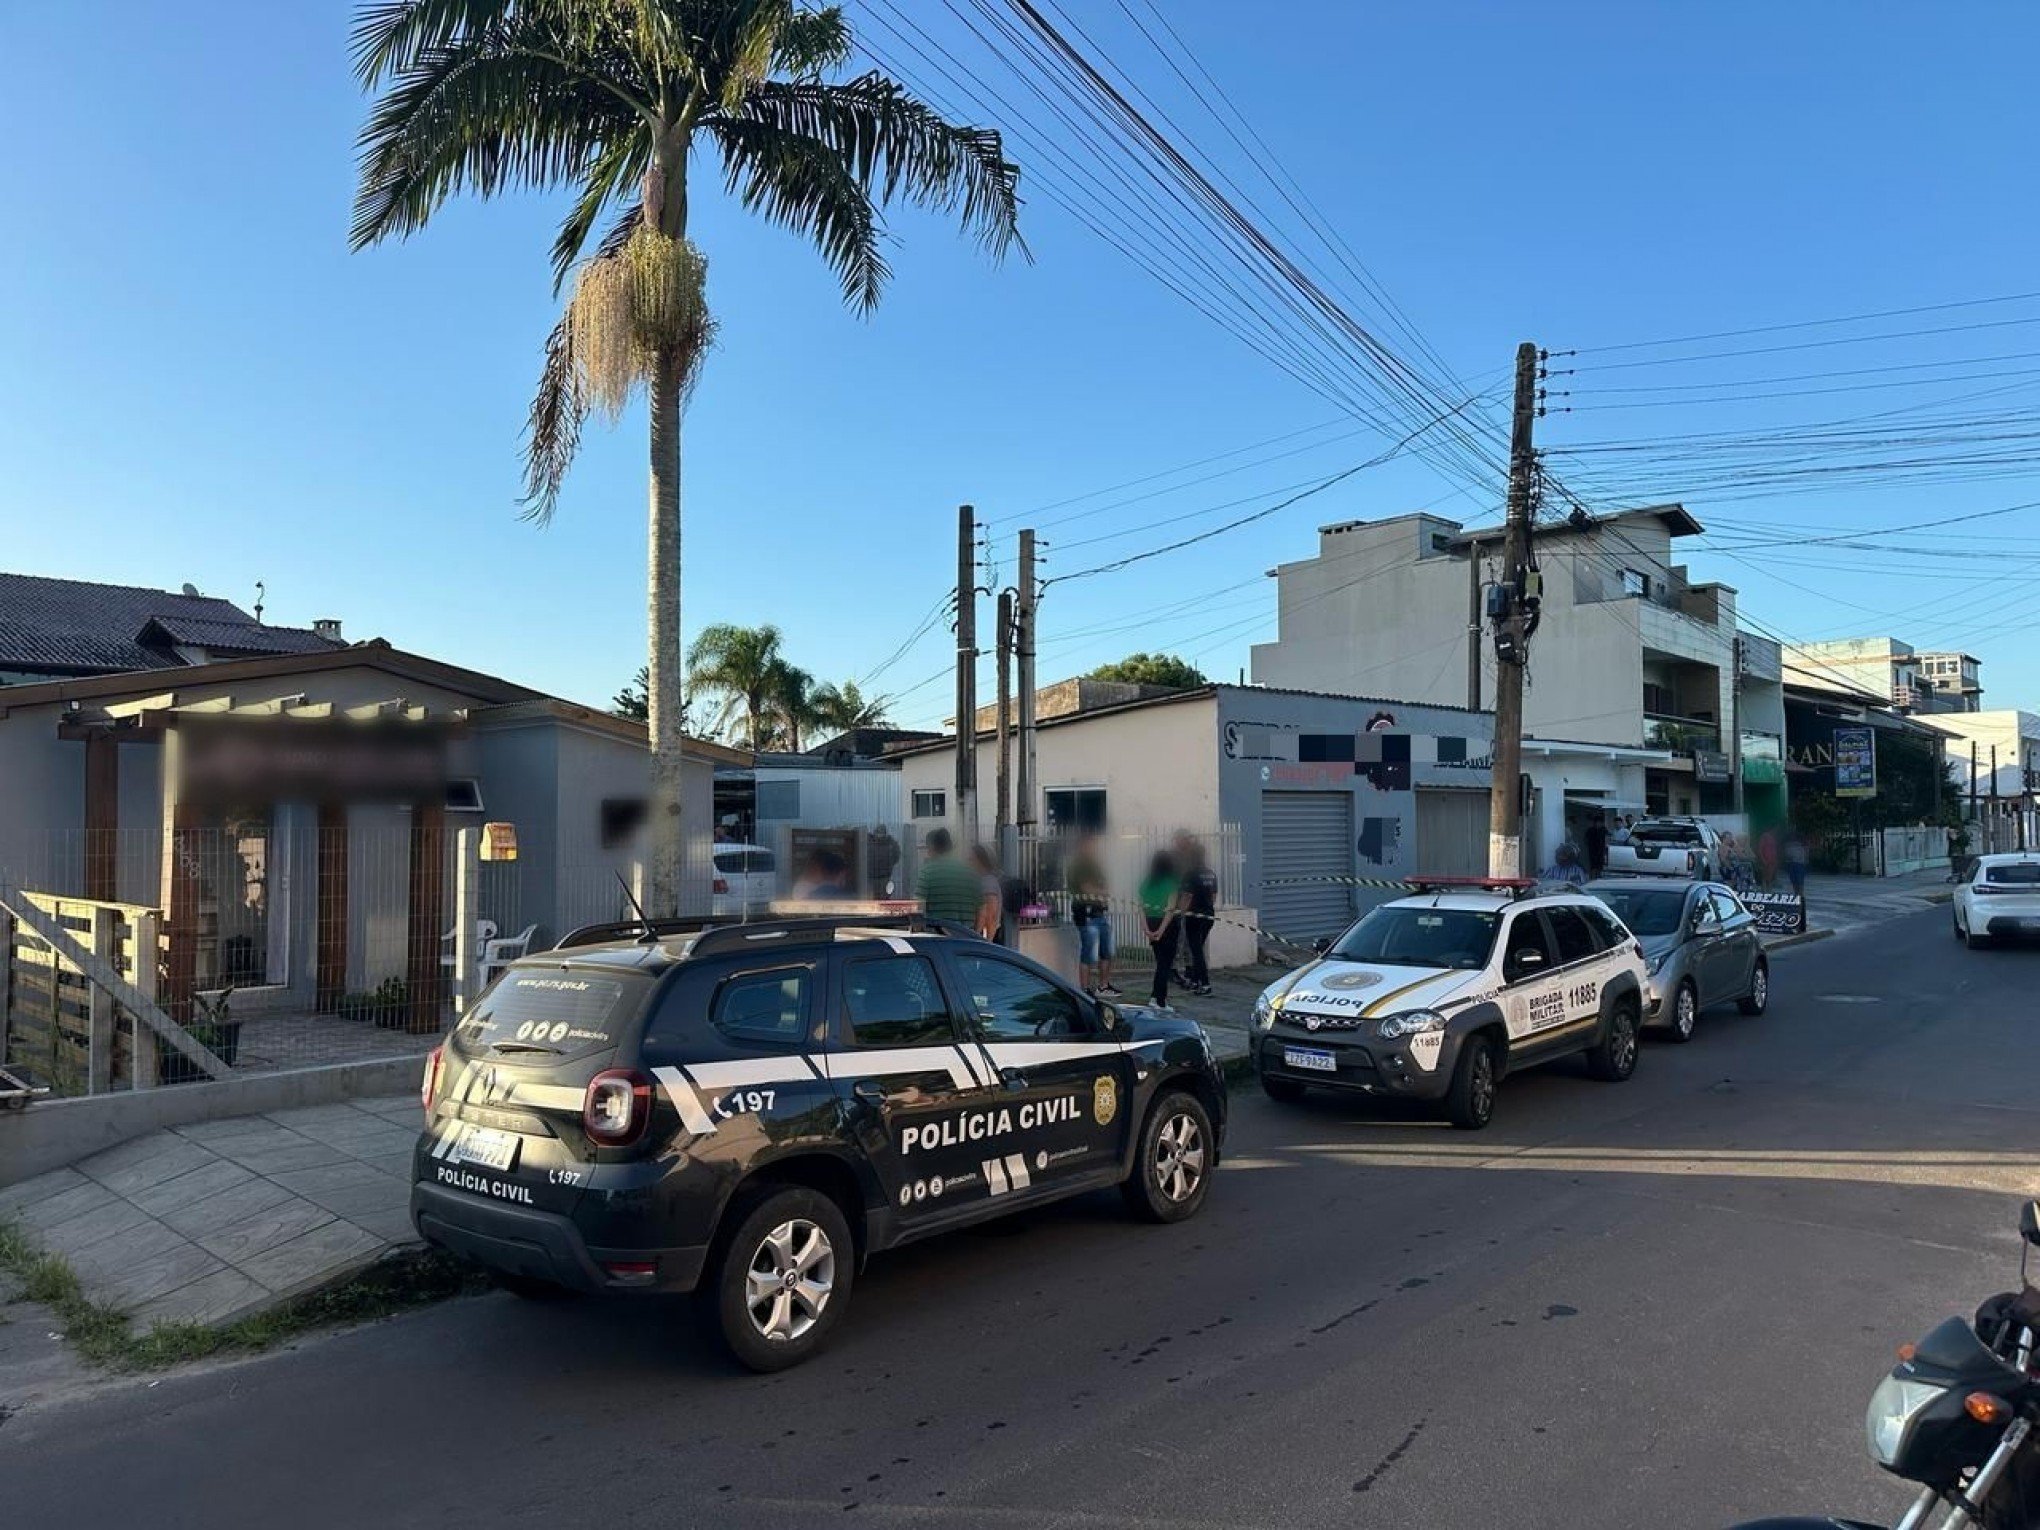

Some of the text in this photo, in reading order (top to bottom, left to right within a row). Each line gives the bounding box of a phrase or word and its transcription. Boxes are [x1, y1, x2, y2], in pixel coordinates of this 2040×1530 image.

[1529, 990, 1564, 1010] BRIGADA
[1529, 1002, 1565, 1021] MILITAR
[732, 1090, 776, 1113] 197
[901, 1095, 1082, 1155] POLÍCIA CIVIL
[437, 1166, 534, 1204] POLÍCIA CIVIL
[557, 1169, 581, 1185] 197
